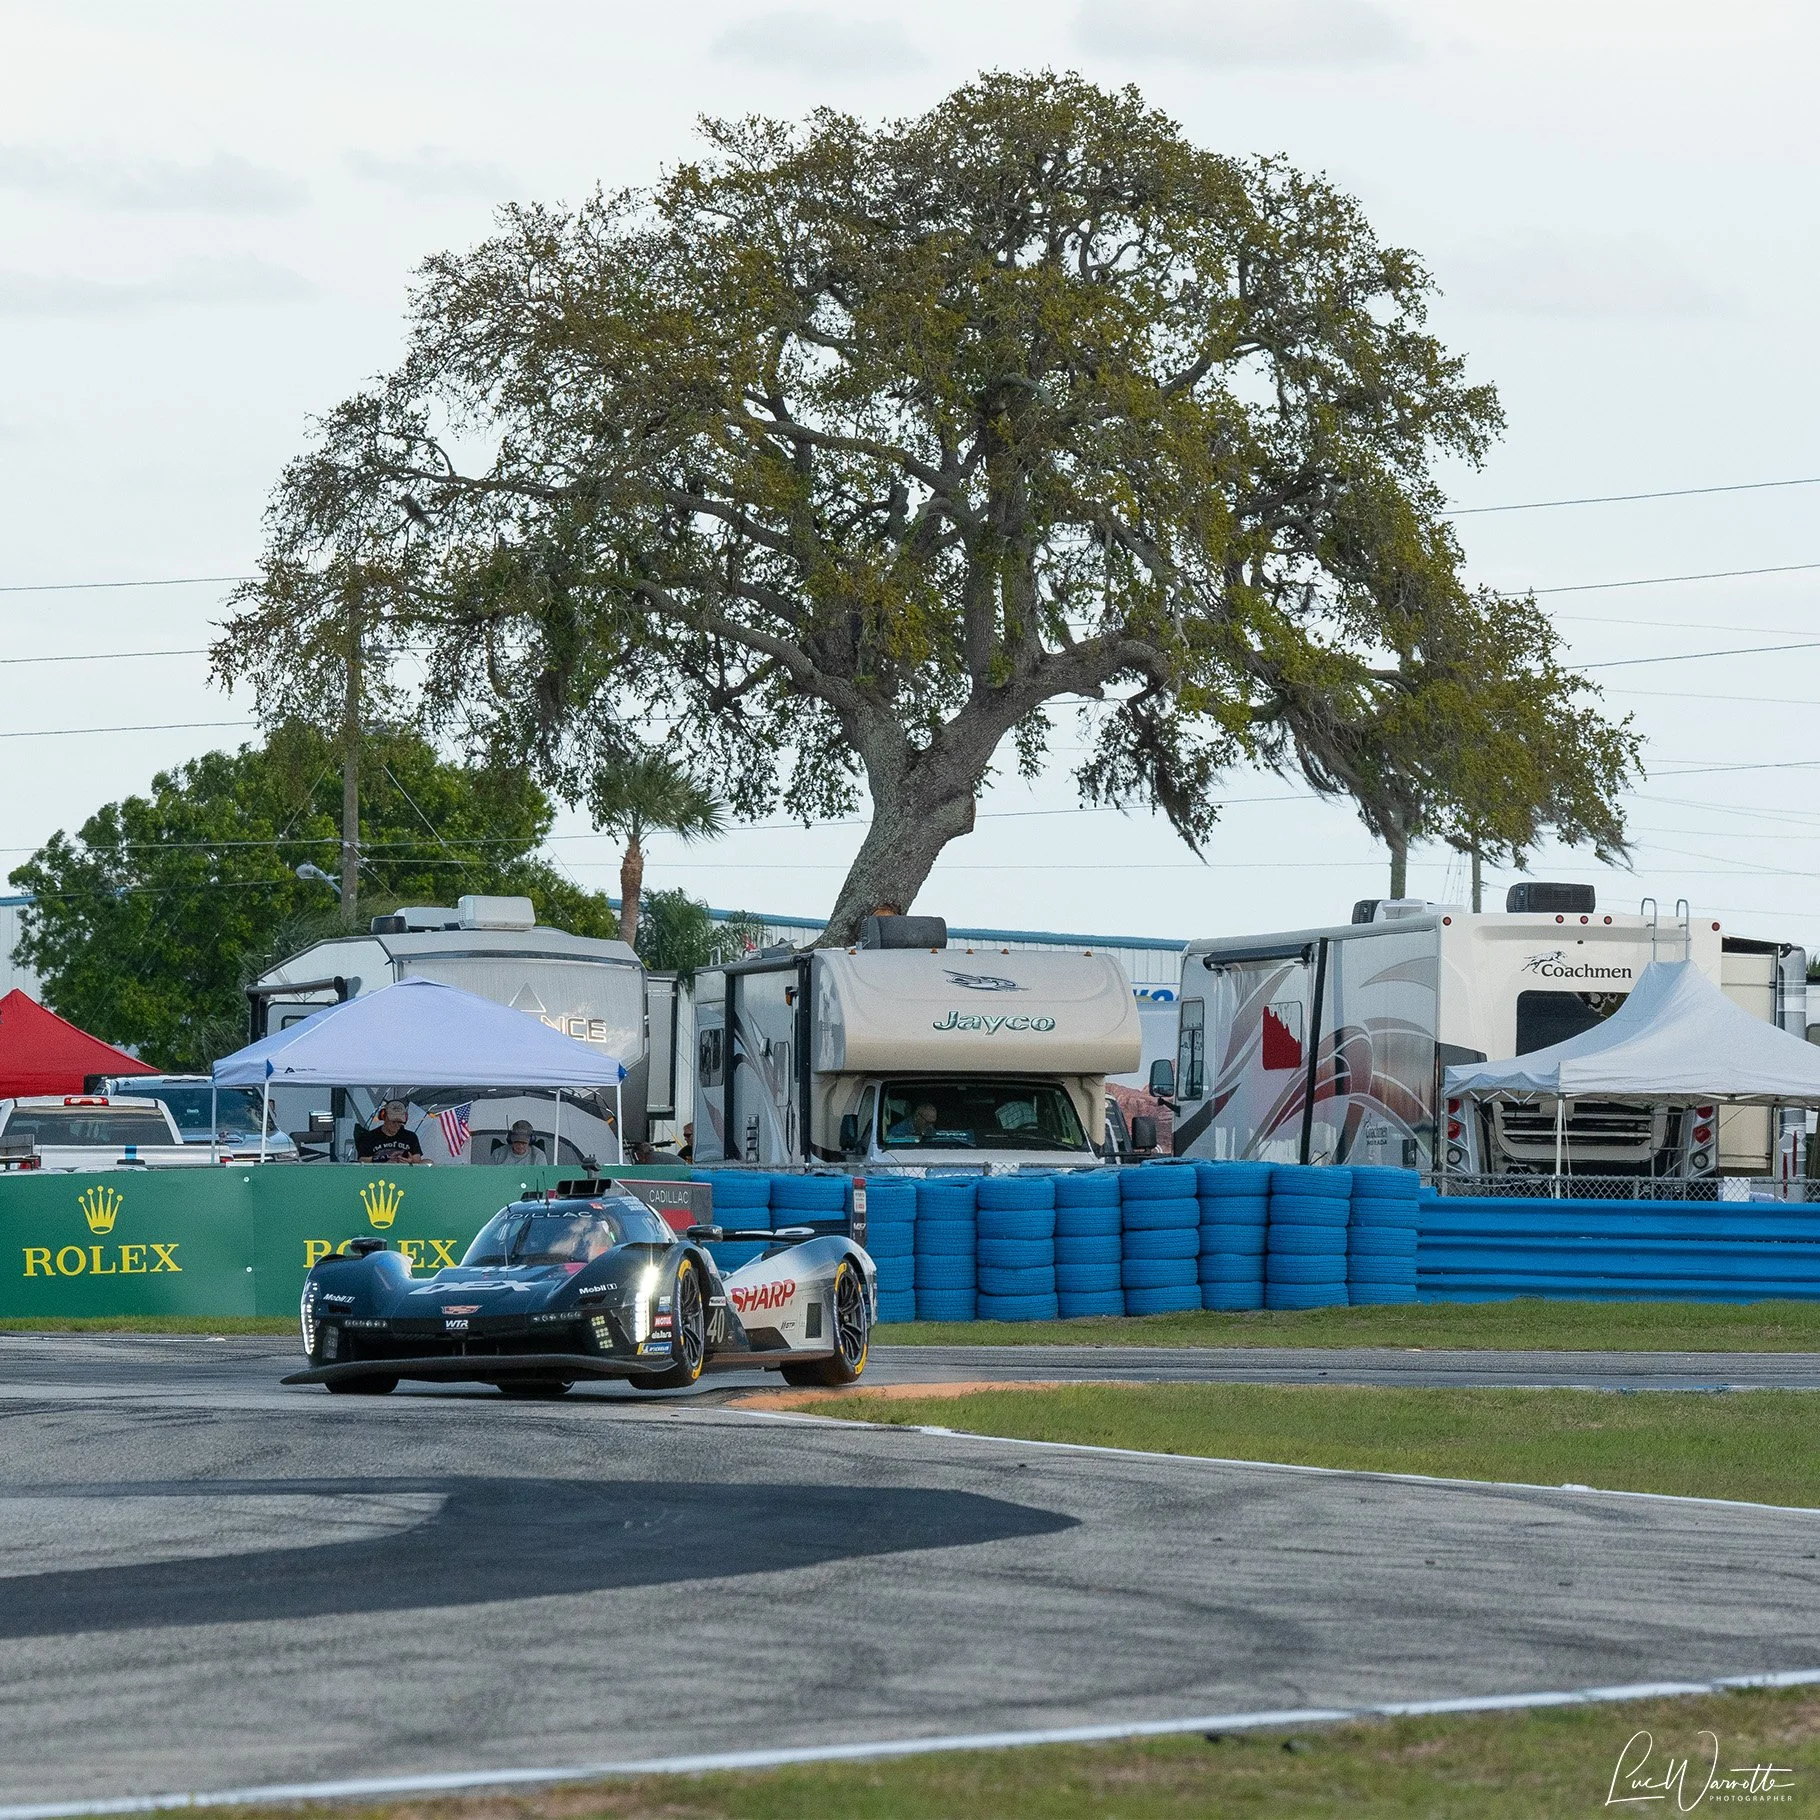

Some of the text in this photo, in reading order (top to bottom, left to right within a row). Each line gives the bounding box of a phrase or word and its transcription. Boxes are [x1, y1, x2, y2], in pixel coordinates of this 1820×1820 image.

[1541, 963, 1632, 979] Coachmen
[932, 1010, 1056, 1036] Jayco
[649, 1189, 689, 1204] CADILLAC
[22, 1243, 183, 1277] ROLEX
[303, 1239, 458, 1269] REX
[408, 1280, 542, 1295] DEX
[579, 1284, 606, 1295] Mobil
[730, 1278, 796, 1313] SHARP
[322, 1293, 347, 1302] Mobil
[445, 1319, 469, 1328] WTR
[706, 1308, 725, 1344] 40
